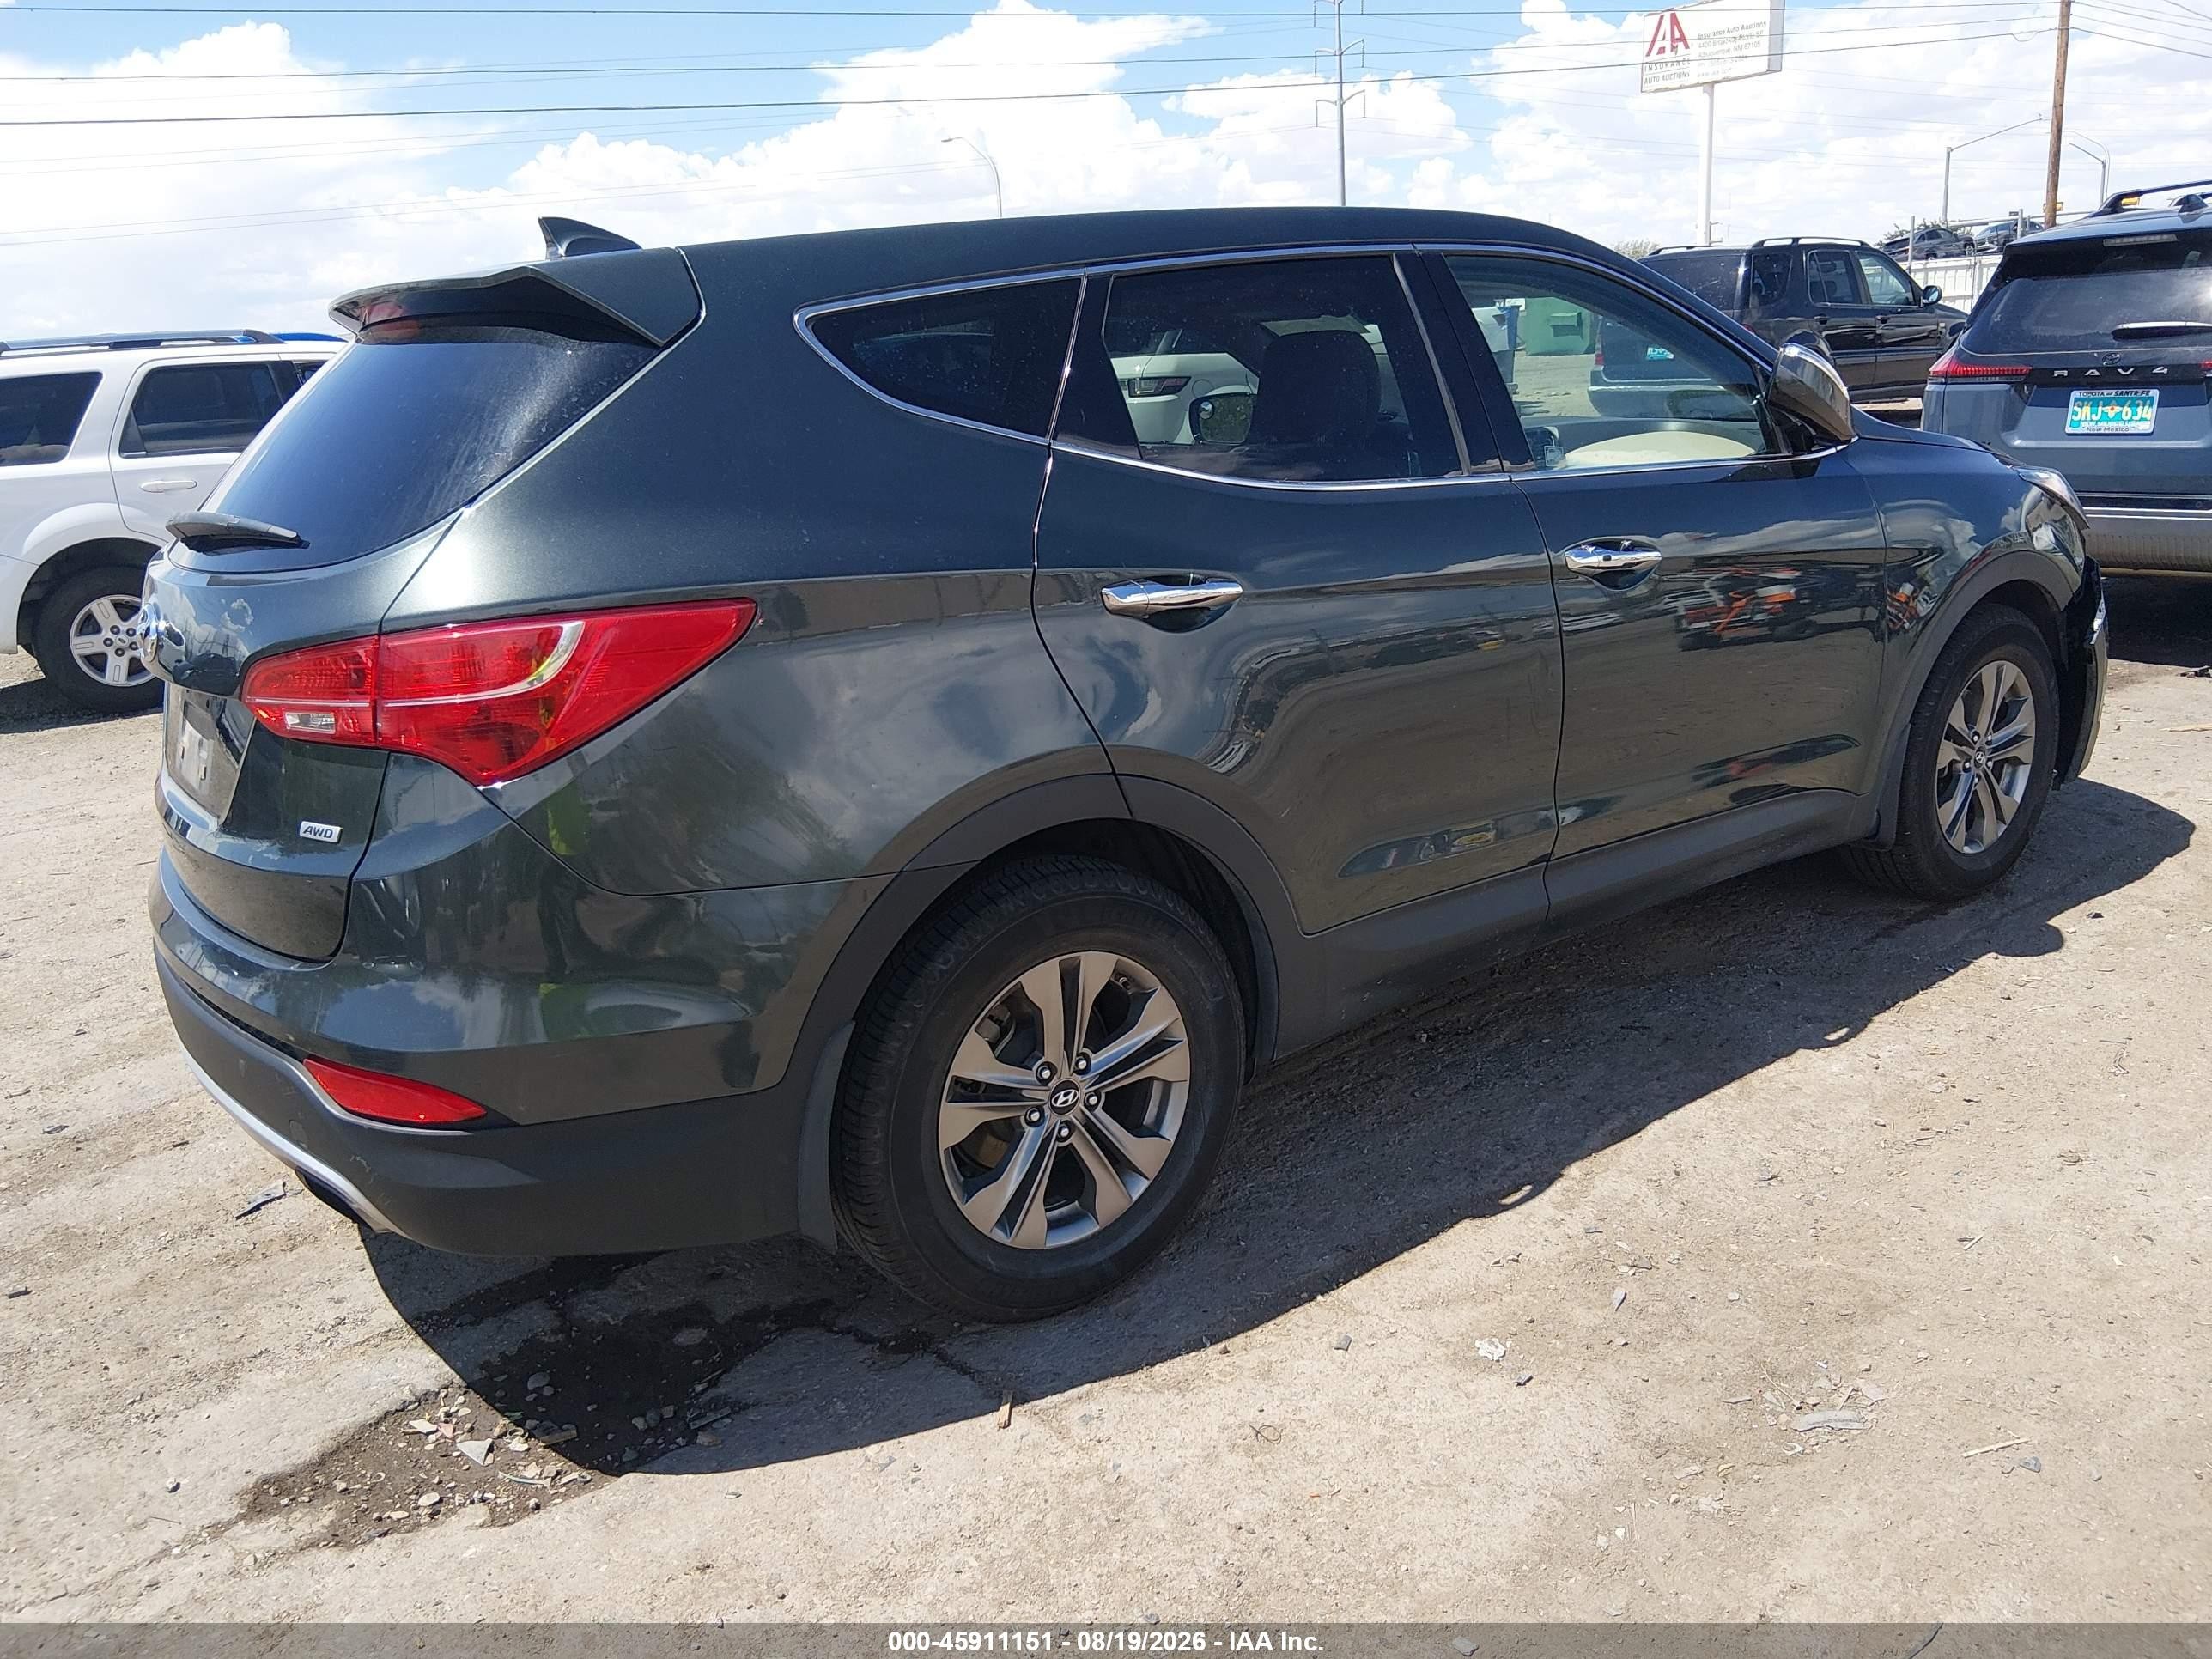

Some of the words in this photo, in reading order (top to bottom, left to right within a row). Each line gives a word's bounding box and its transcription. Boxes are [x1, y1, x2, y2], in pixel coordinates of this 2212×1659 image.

[1698, 29, 1726, 40] Insurance
[1741, 21, 1767, 31] Auctions
[1644, 57, 1691, 73] INSURANCE
[1644, 76, 1660, 84] AUTO
[1662, 70, 1690, 82] AUCTIONS
[2053, 366, 2168, 377] RAV4
[303, 825, 333, 839] AWD
